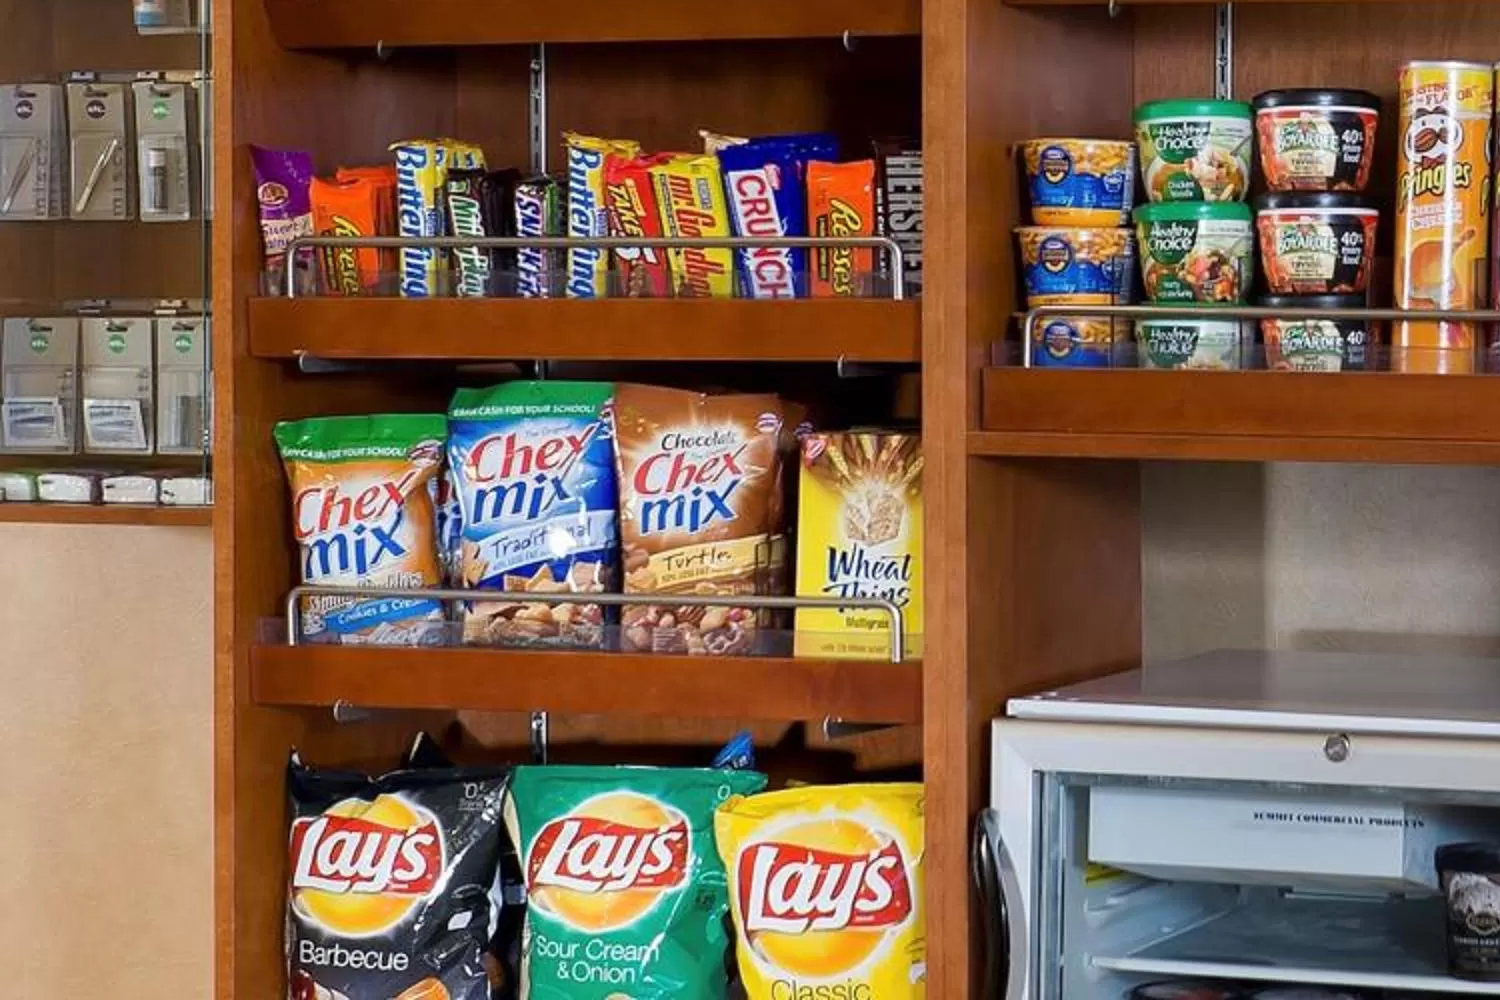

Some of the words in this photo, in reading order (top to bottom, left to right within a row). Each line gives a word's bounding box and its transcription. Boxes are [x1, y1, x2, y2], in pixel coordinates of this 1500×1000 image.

[1155, 135, 1201, 151] Choice
[606, 183, 645, 238] TAKE
[467, 422, 600, 484] Chex
[661, 430, 739, 452] Chocolate
[633, 443, 748, 496] Chex
[295, 471, 418, 540] Chex
[471, 472, 573, 524] mix
[640, 480, 740, 534] mix
[305, 508, 407, 580] mix
[492, 519, 593, 559] Traditnal
[663, 548, 732, 571] Turtle
[828, 542, 913, 583] Wheat
[1297, 813, 1364, 825] COMMERCIAL
[294, 817, 428, 894] Lay's
[535, 820, 684, 893] Lay's
[747, 842, 902, 934] Lay's
[299, 940, 410, 973] Barbecue
[535, 935, 583, 961] Sour
[585, 939, 660, 963] Cream
[571, 960, 636, 985] Onion
[770, 979, 871, 1000] Classic
